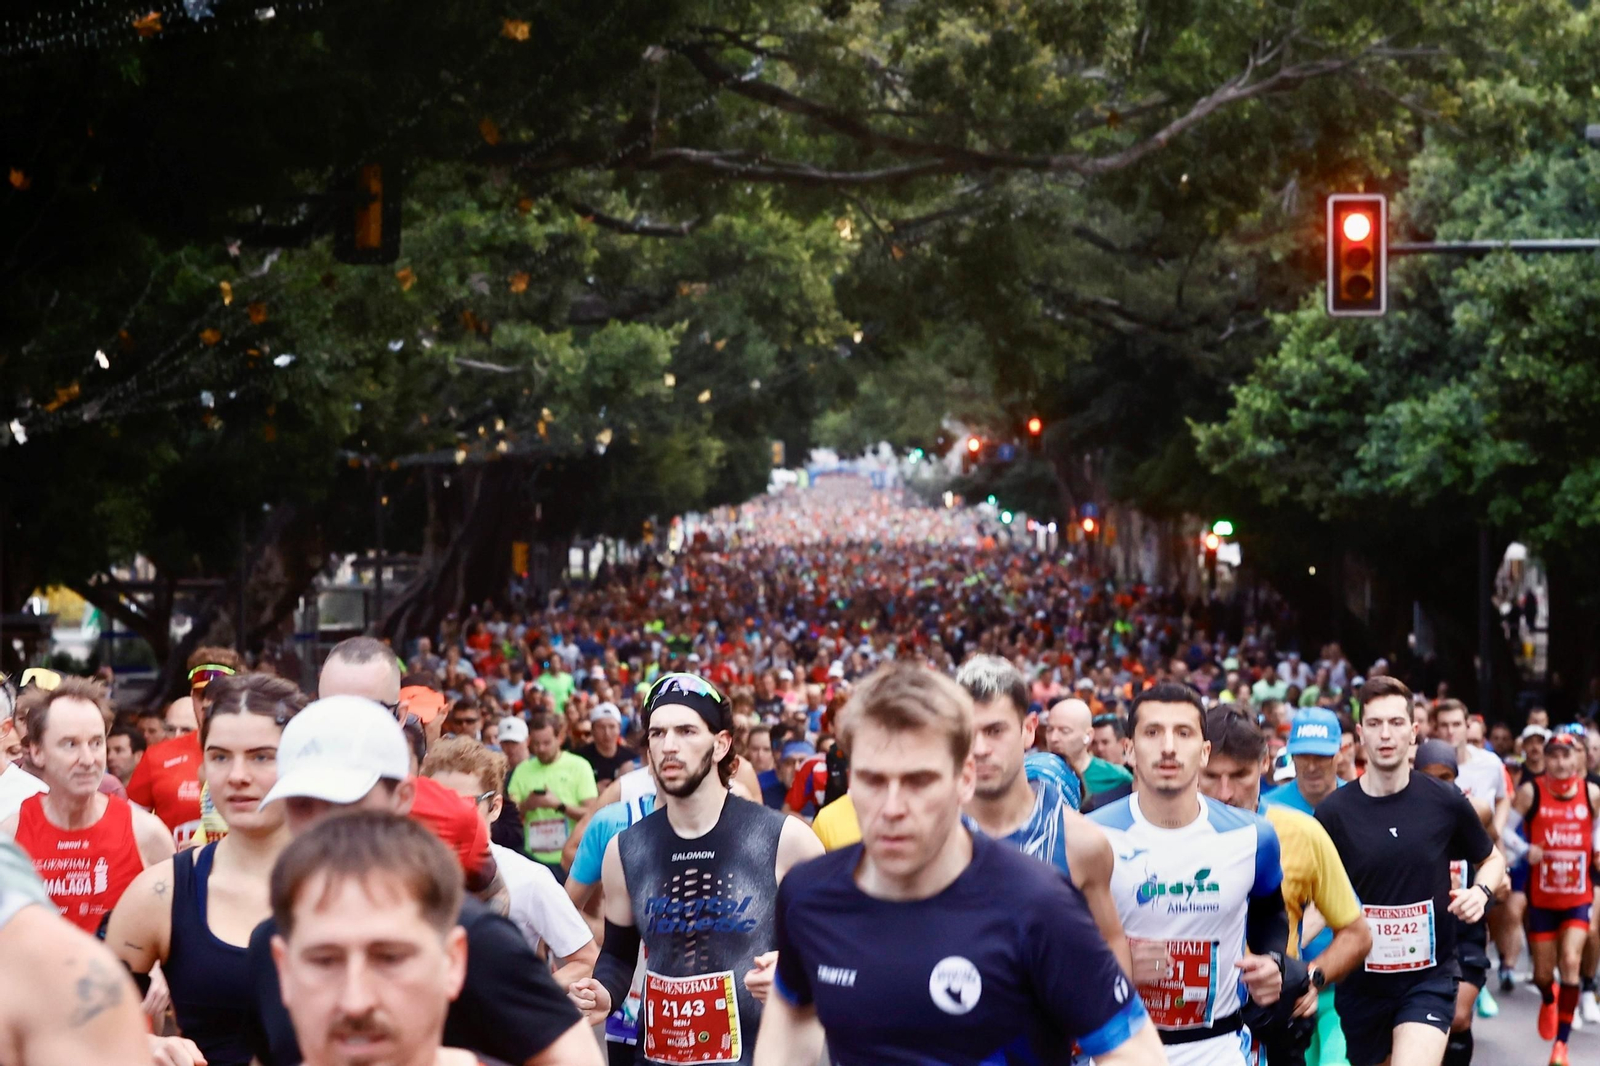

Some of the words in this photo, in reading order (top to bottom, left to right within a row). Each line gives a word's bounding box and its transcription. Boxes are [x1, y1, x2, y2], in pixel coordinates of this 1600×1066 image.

[1297, 724, 1328, 738] HOKA
[671, 851, 715, 862] SALOMON
[1380, 905, 1424, 919] GENERALI
[1376, 922, 1418, 935] 18242
[662, 998, 706, 1018] 2143
